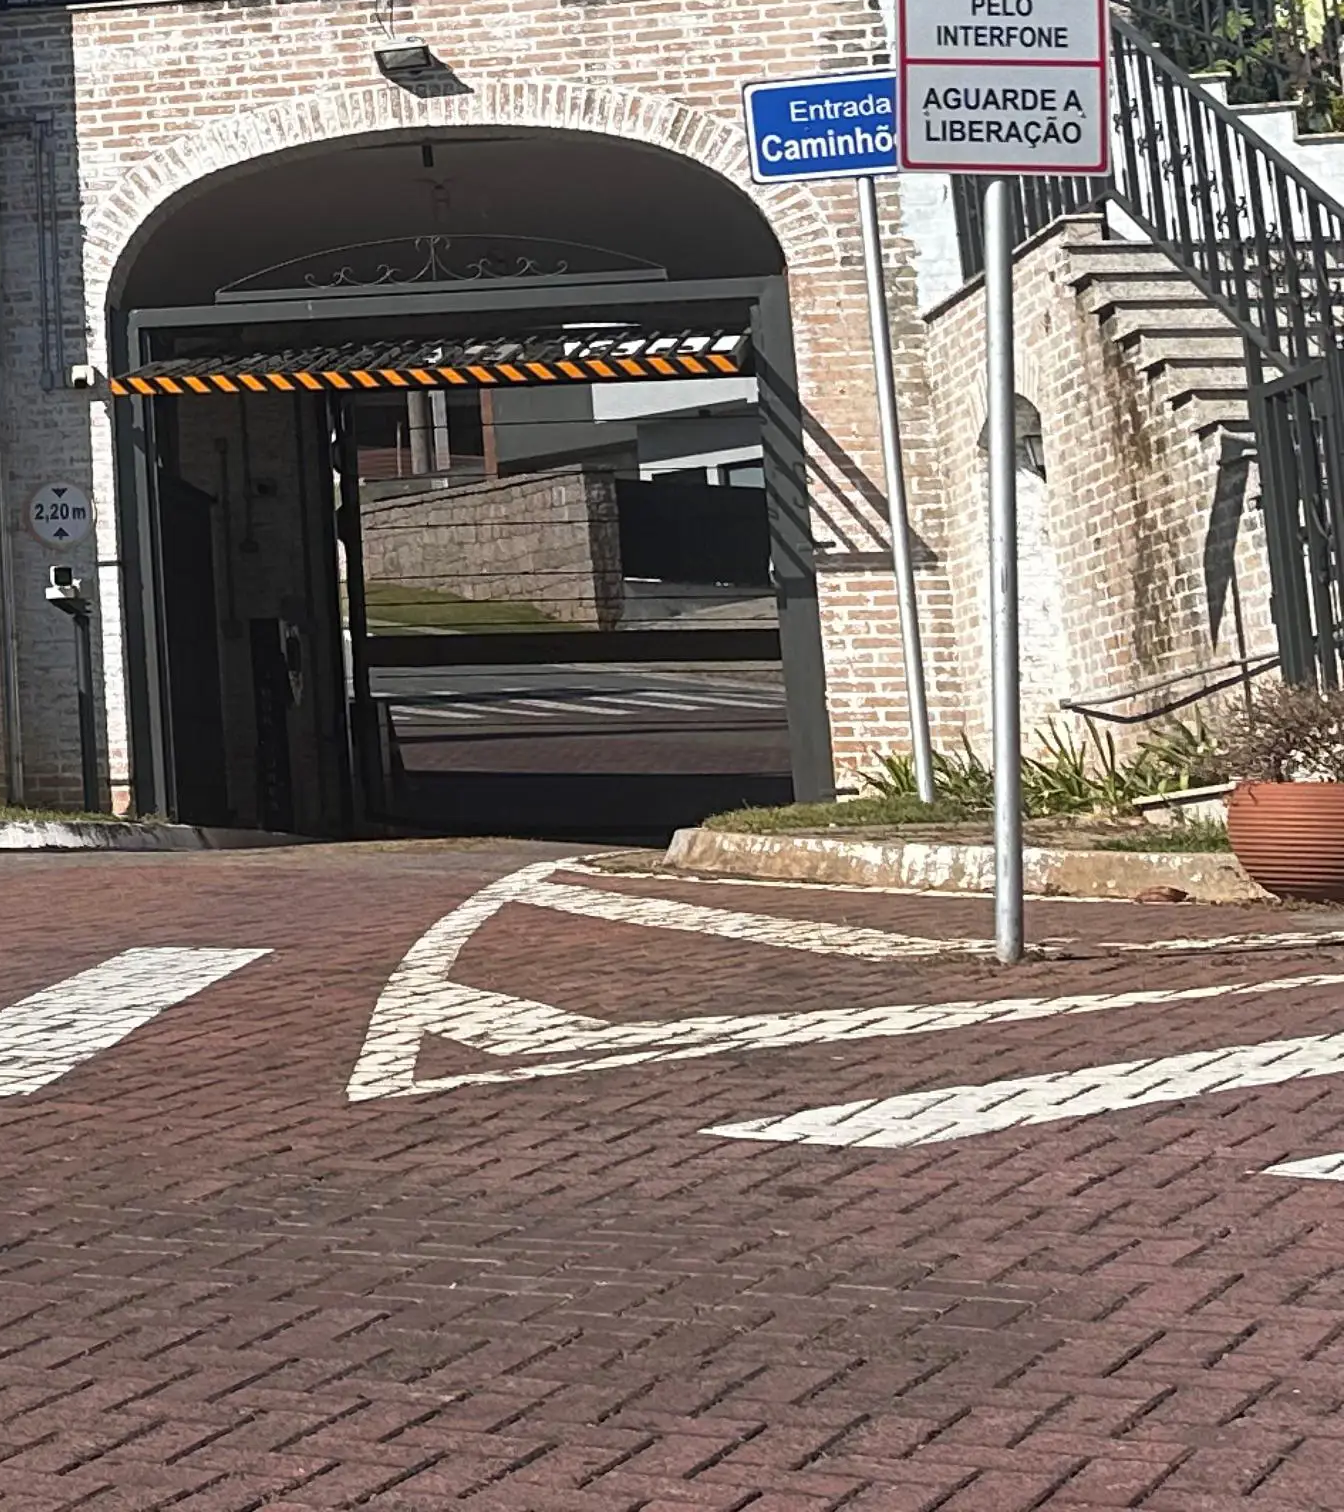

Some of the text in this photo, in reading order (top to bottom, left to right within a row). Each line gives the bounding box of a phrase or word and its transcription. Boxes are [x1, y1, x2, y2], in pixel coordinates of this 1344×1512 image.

[936, 25, 1069, 48] INTERFONE
[789, 93, 892, 122] Entrada
[923, 87, 1083, 111] AGUARDE A
[761, 124, 896, 162] Caminhõ
[925, 116, 1082, 149] LIBERAÇÃO
[34, 503, 86, 524] 2,20 m
